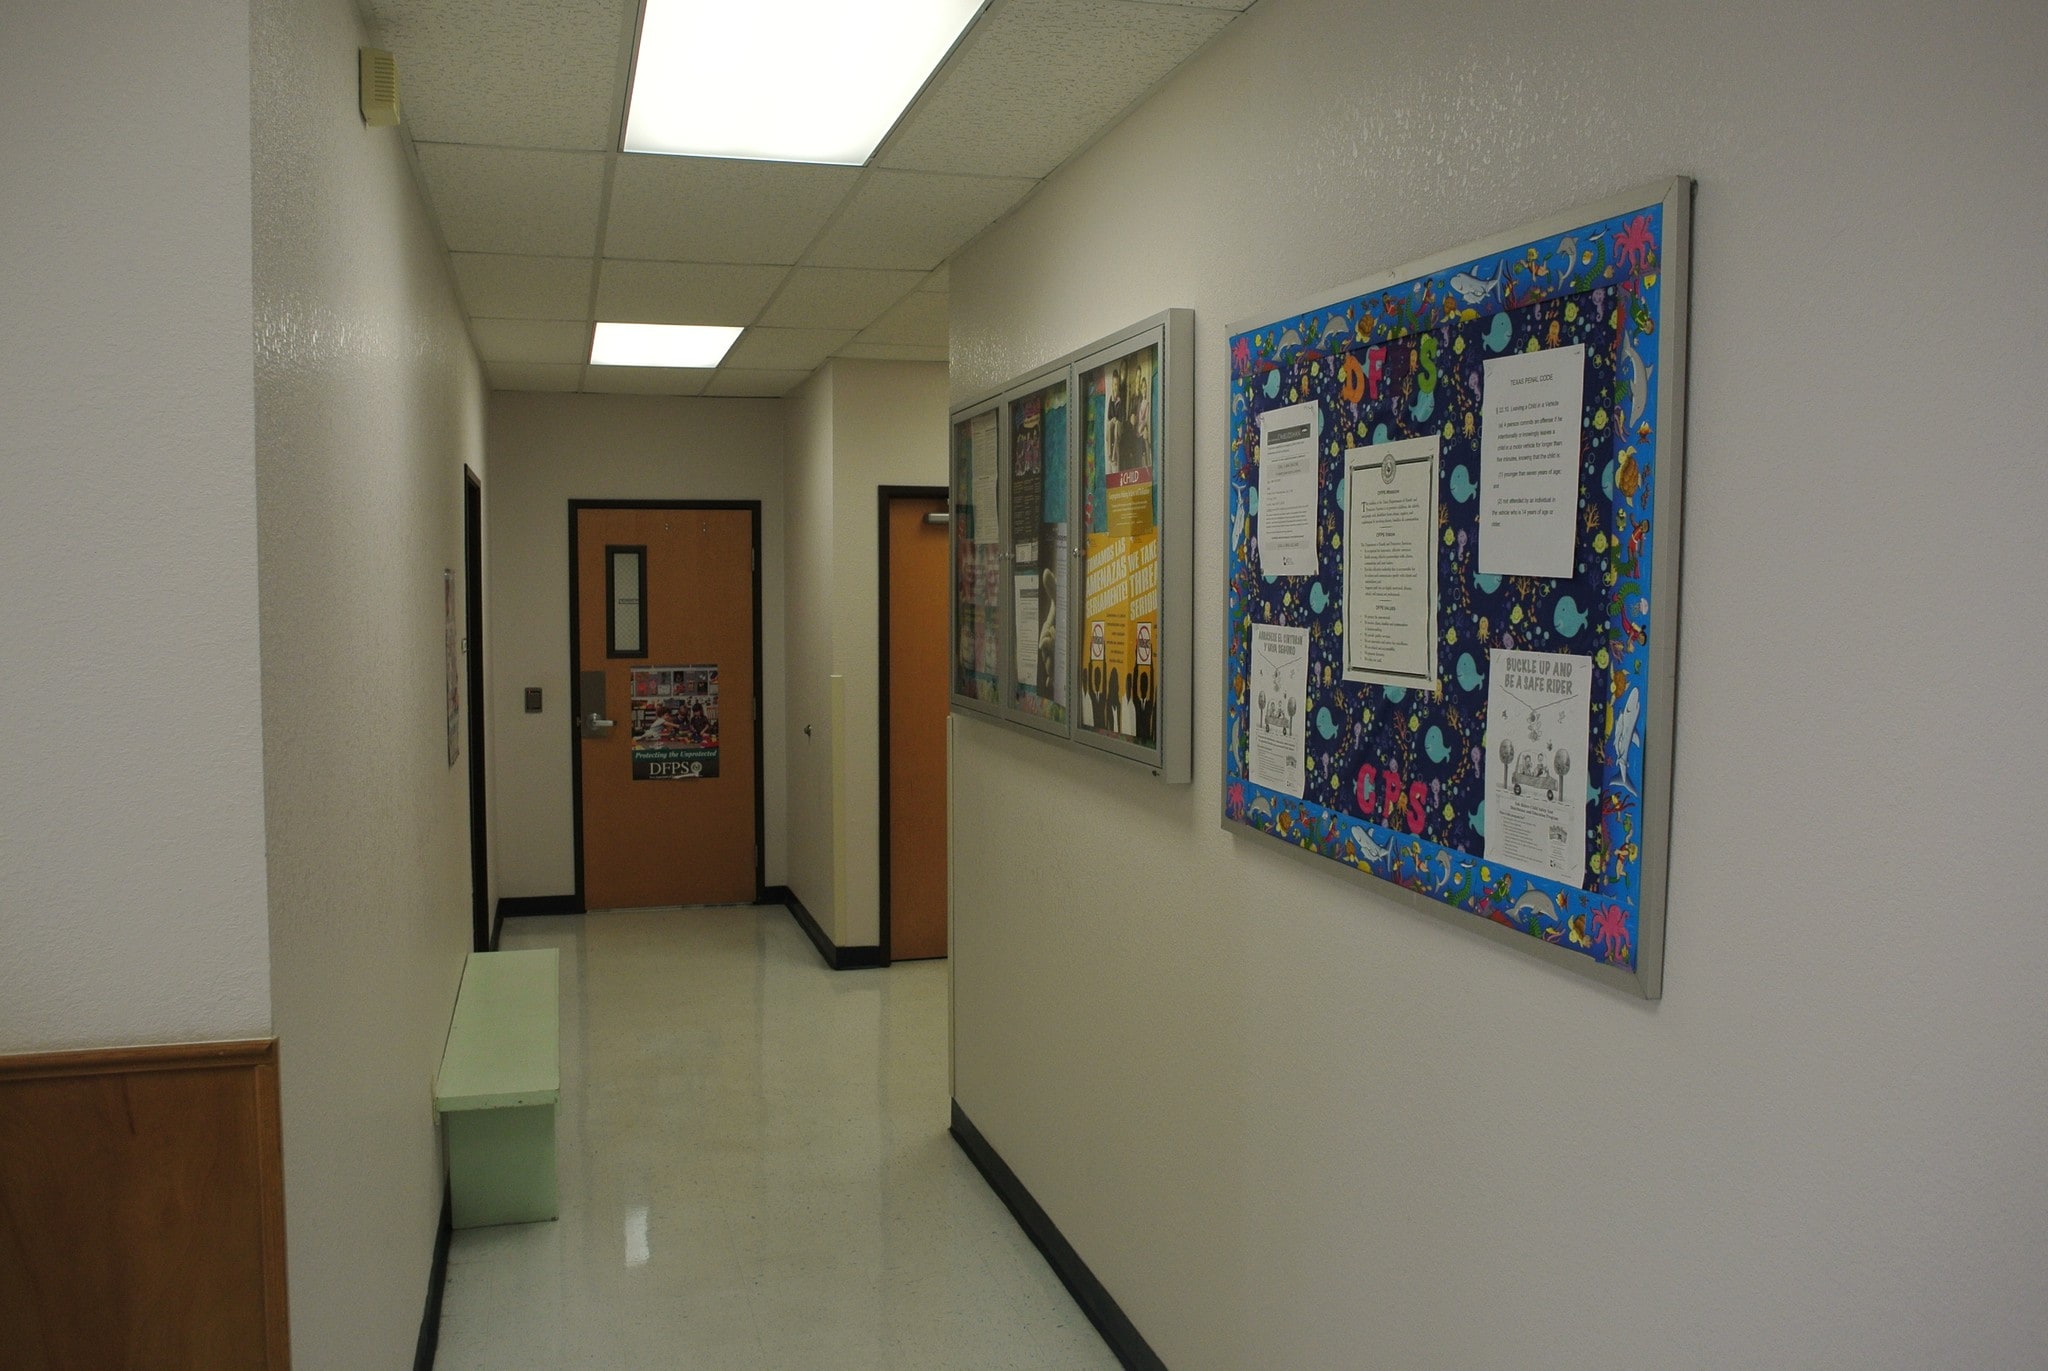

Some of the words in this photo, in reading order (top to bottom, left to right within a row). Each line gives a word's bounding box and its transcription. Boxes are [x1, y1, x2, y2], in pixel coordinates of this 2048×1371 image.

[1540, 374, 1554, 382] CODE
[1114, 536, 1127, 558] LAS
[1128, 550, 1139, 573] WE
[1506, 657, 1538, 674] BUCKLE
[1538, 660, 1551, 676] UP
[1552, 661, 1573, 678] AND
[1504, 673, 1515, 688] BE
[1516, 675, 1522, 690] A
[1523, 675, 1545, 692] SAFE
[1546, 678, 1573, 696] RIDER
[635, 752, 668, 760] Protecting
[668, 750, 680, 759] the
[680, 750, 718, 759] Unprotected
[650, 761, 690, 776] DFPS
[1357, 763, 1428, 834] CPS
